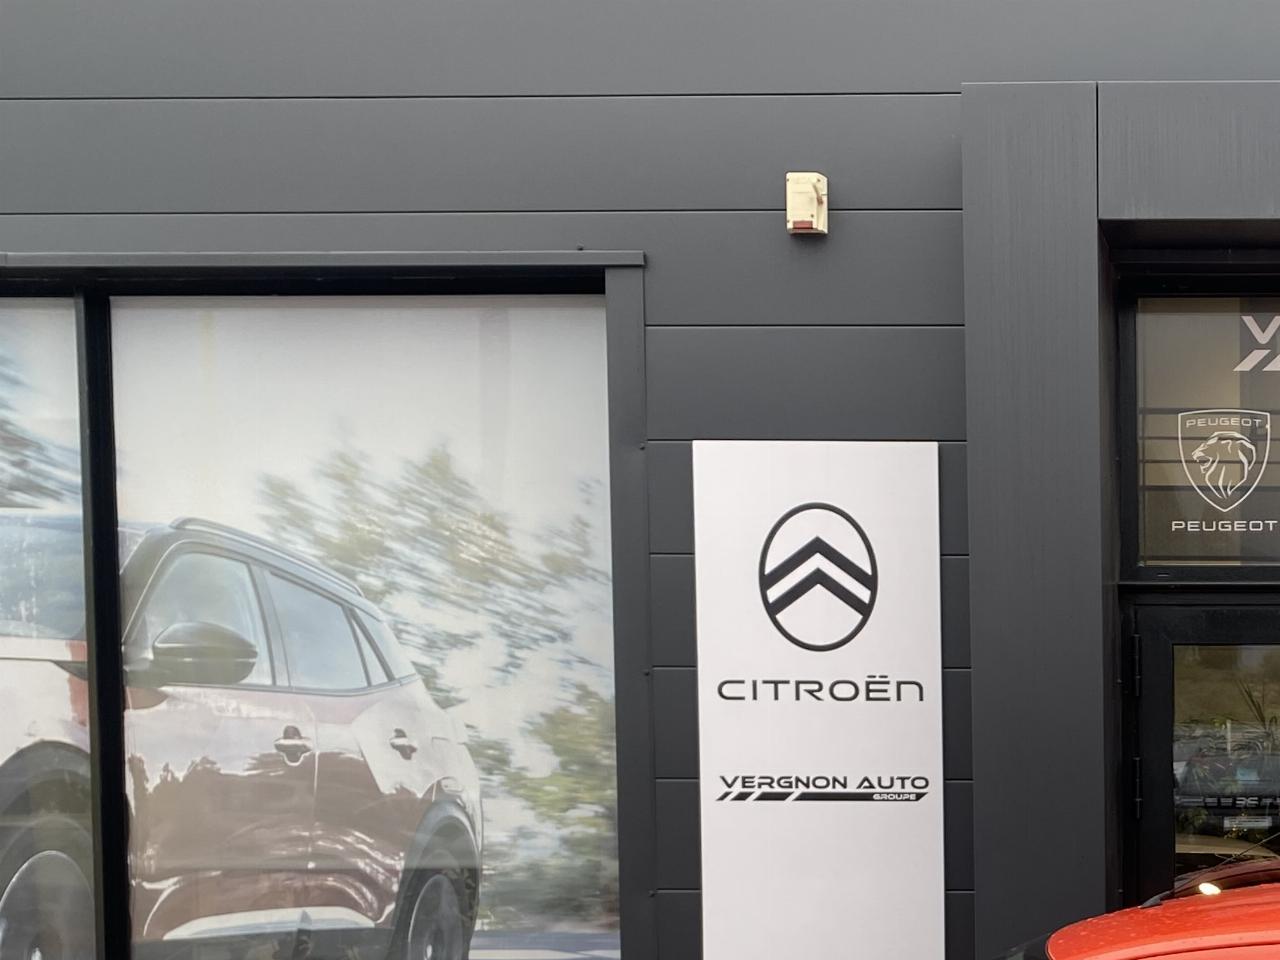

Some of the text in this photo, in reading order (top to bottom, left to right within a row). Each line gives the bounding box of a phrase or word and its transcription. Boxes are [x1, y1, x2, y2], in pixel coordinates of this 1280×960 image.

[1186, 418, 1261, 427] PEUGEOT
[1172, 521, 1277, 531] PEUGEOT
[720, 776, 929, 789] VERGNON AUTO
[872, 793, 917, 801] GROUPE
